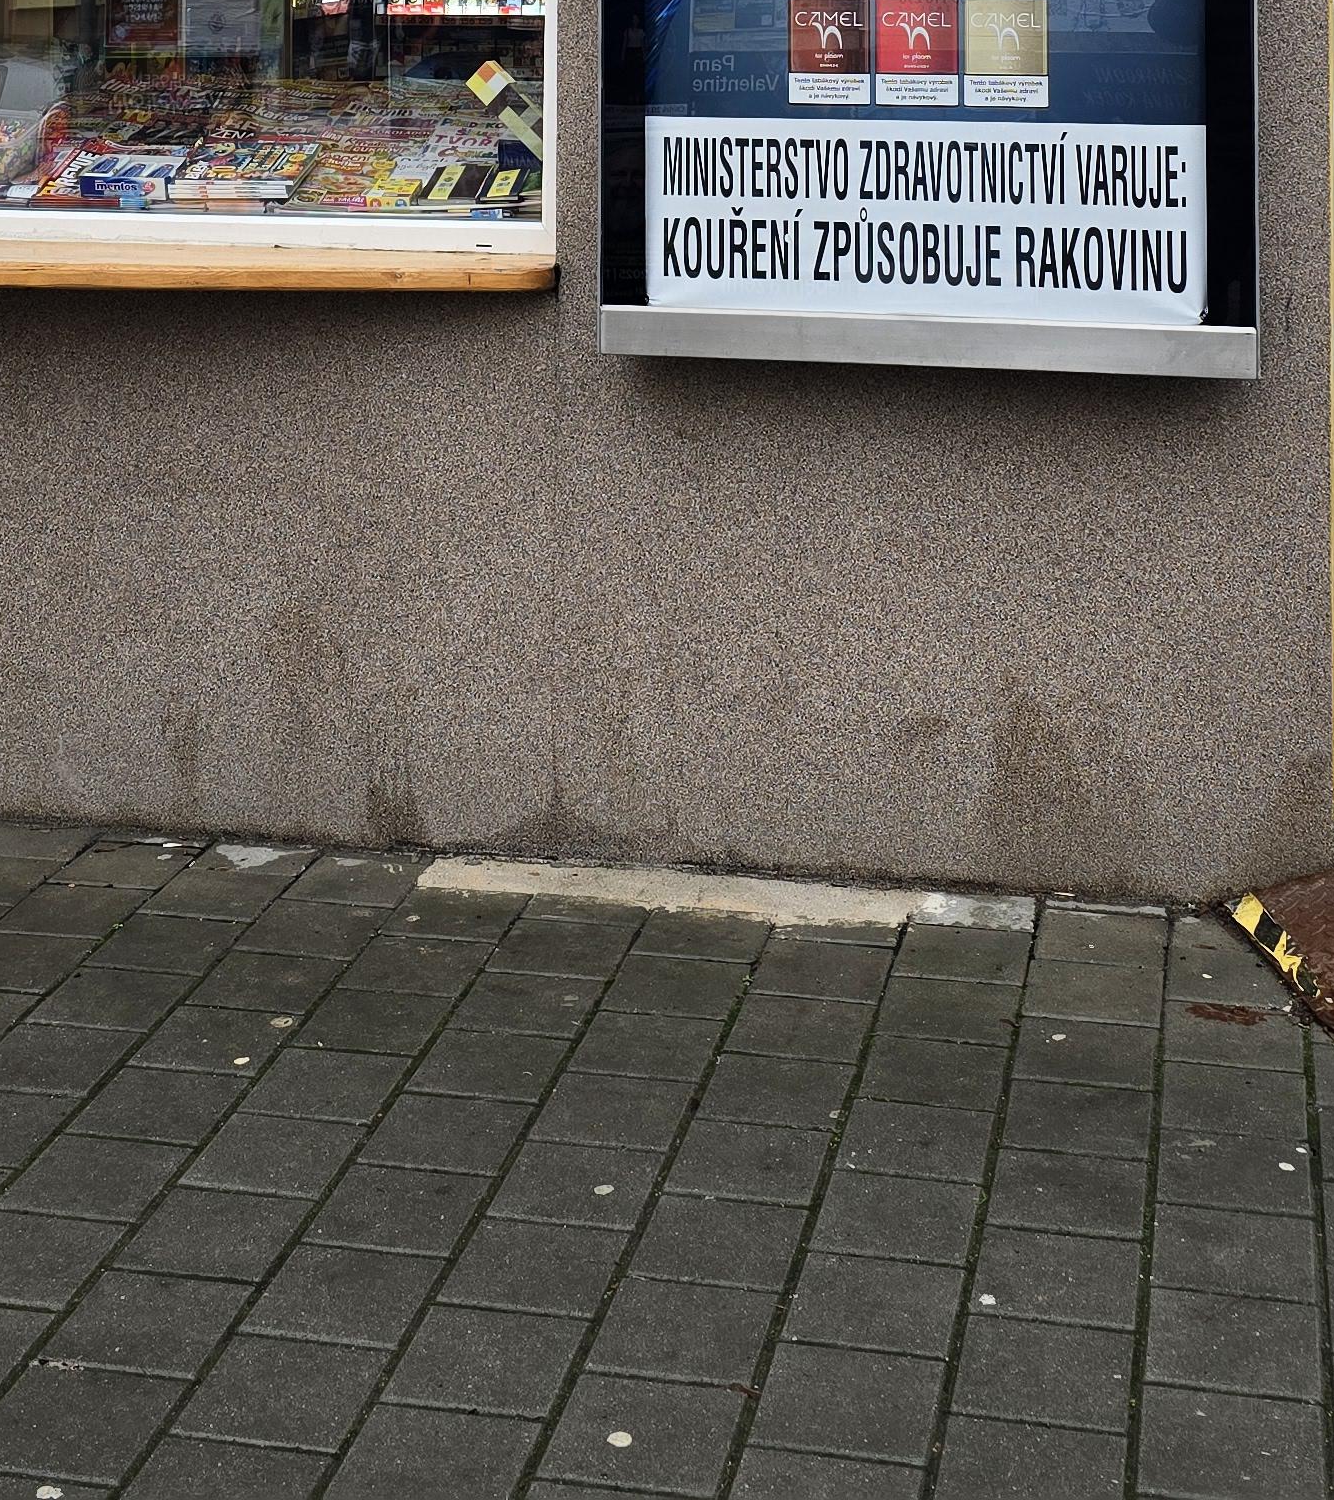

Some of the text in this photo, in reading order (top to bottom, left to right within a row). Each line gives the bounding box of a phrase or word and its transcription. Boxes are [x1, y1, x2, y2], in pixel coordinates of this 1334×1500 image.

[794, 11, 864, 27] CAMEL
[882, 11, 952, 28] CAMEL
[970, 12, 1042, 28] CAMEL
[663, 132, 1188, 208] MINISTERSTVO ZDRAVOTNICTVÍ VARUJE:
[94, 181, 138, 192] mentos
[663, 206, 1188, 294] KOUŘENÍ ZPŮSOBUJE RAKOVINU
